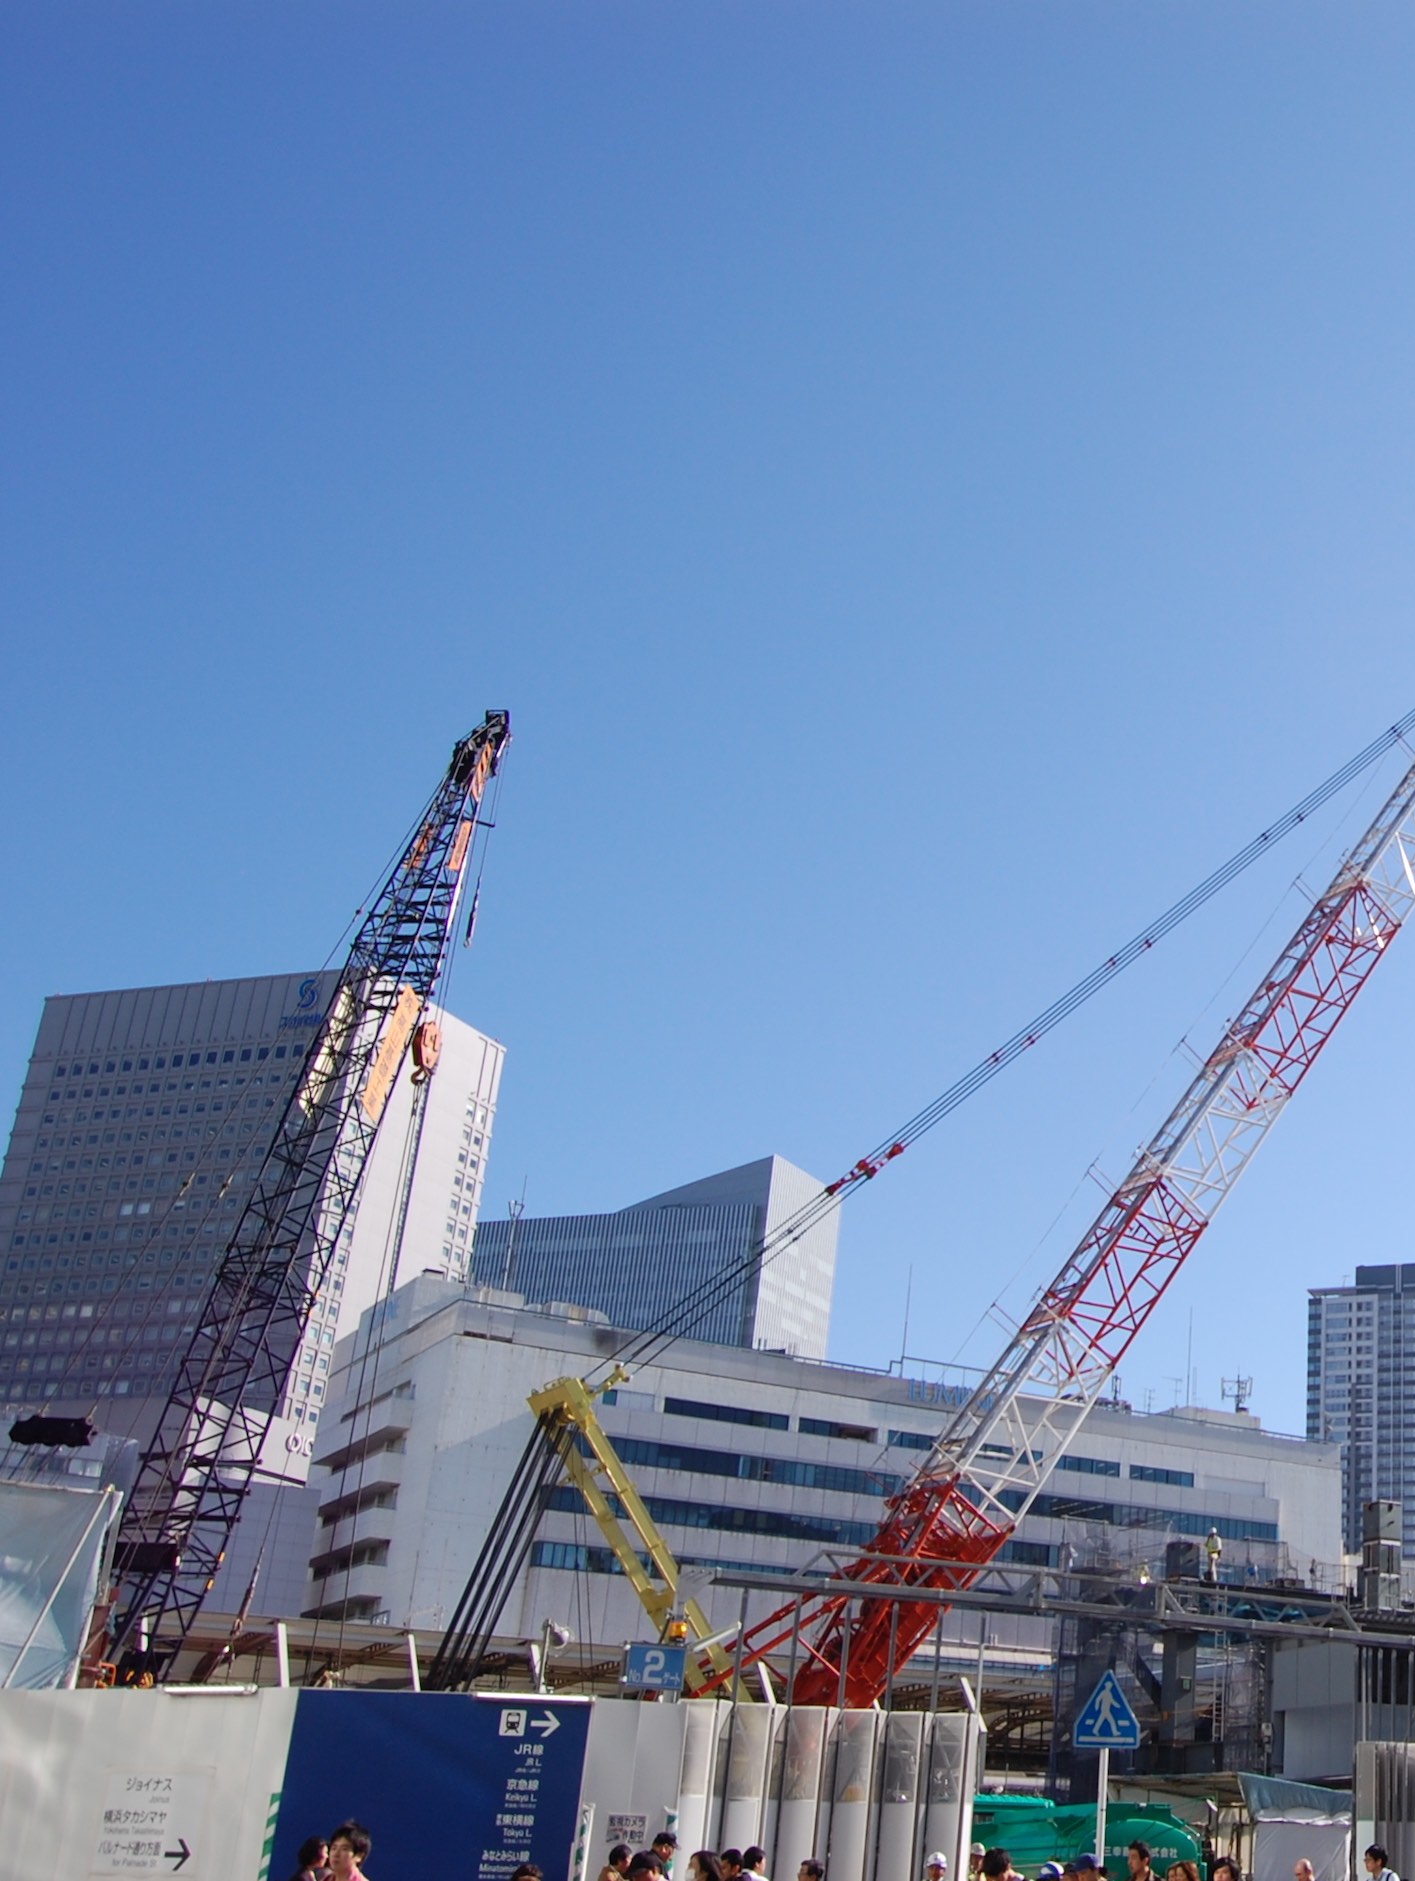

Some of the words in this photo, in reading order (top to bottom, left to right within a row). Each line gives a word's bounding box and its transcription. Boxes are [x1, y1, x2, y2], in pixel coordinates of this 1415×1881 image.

[642, 1650, 666, 1684] 2
[513, 1743, 544, 1756] JR線
[126, 1778, 172, 1791] ジョイナス
[104, 1809, 167, 1823] 横浜タカシマヤ
[482, 1850, 531, 1862] みなとみらい線
